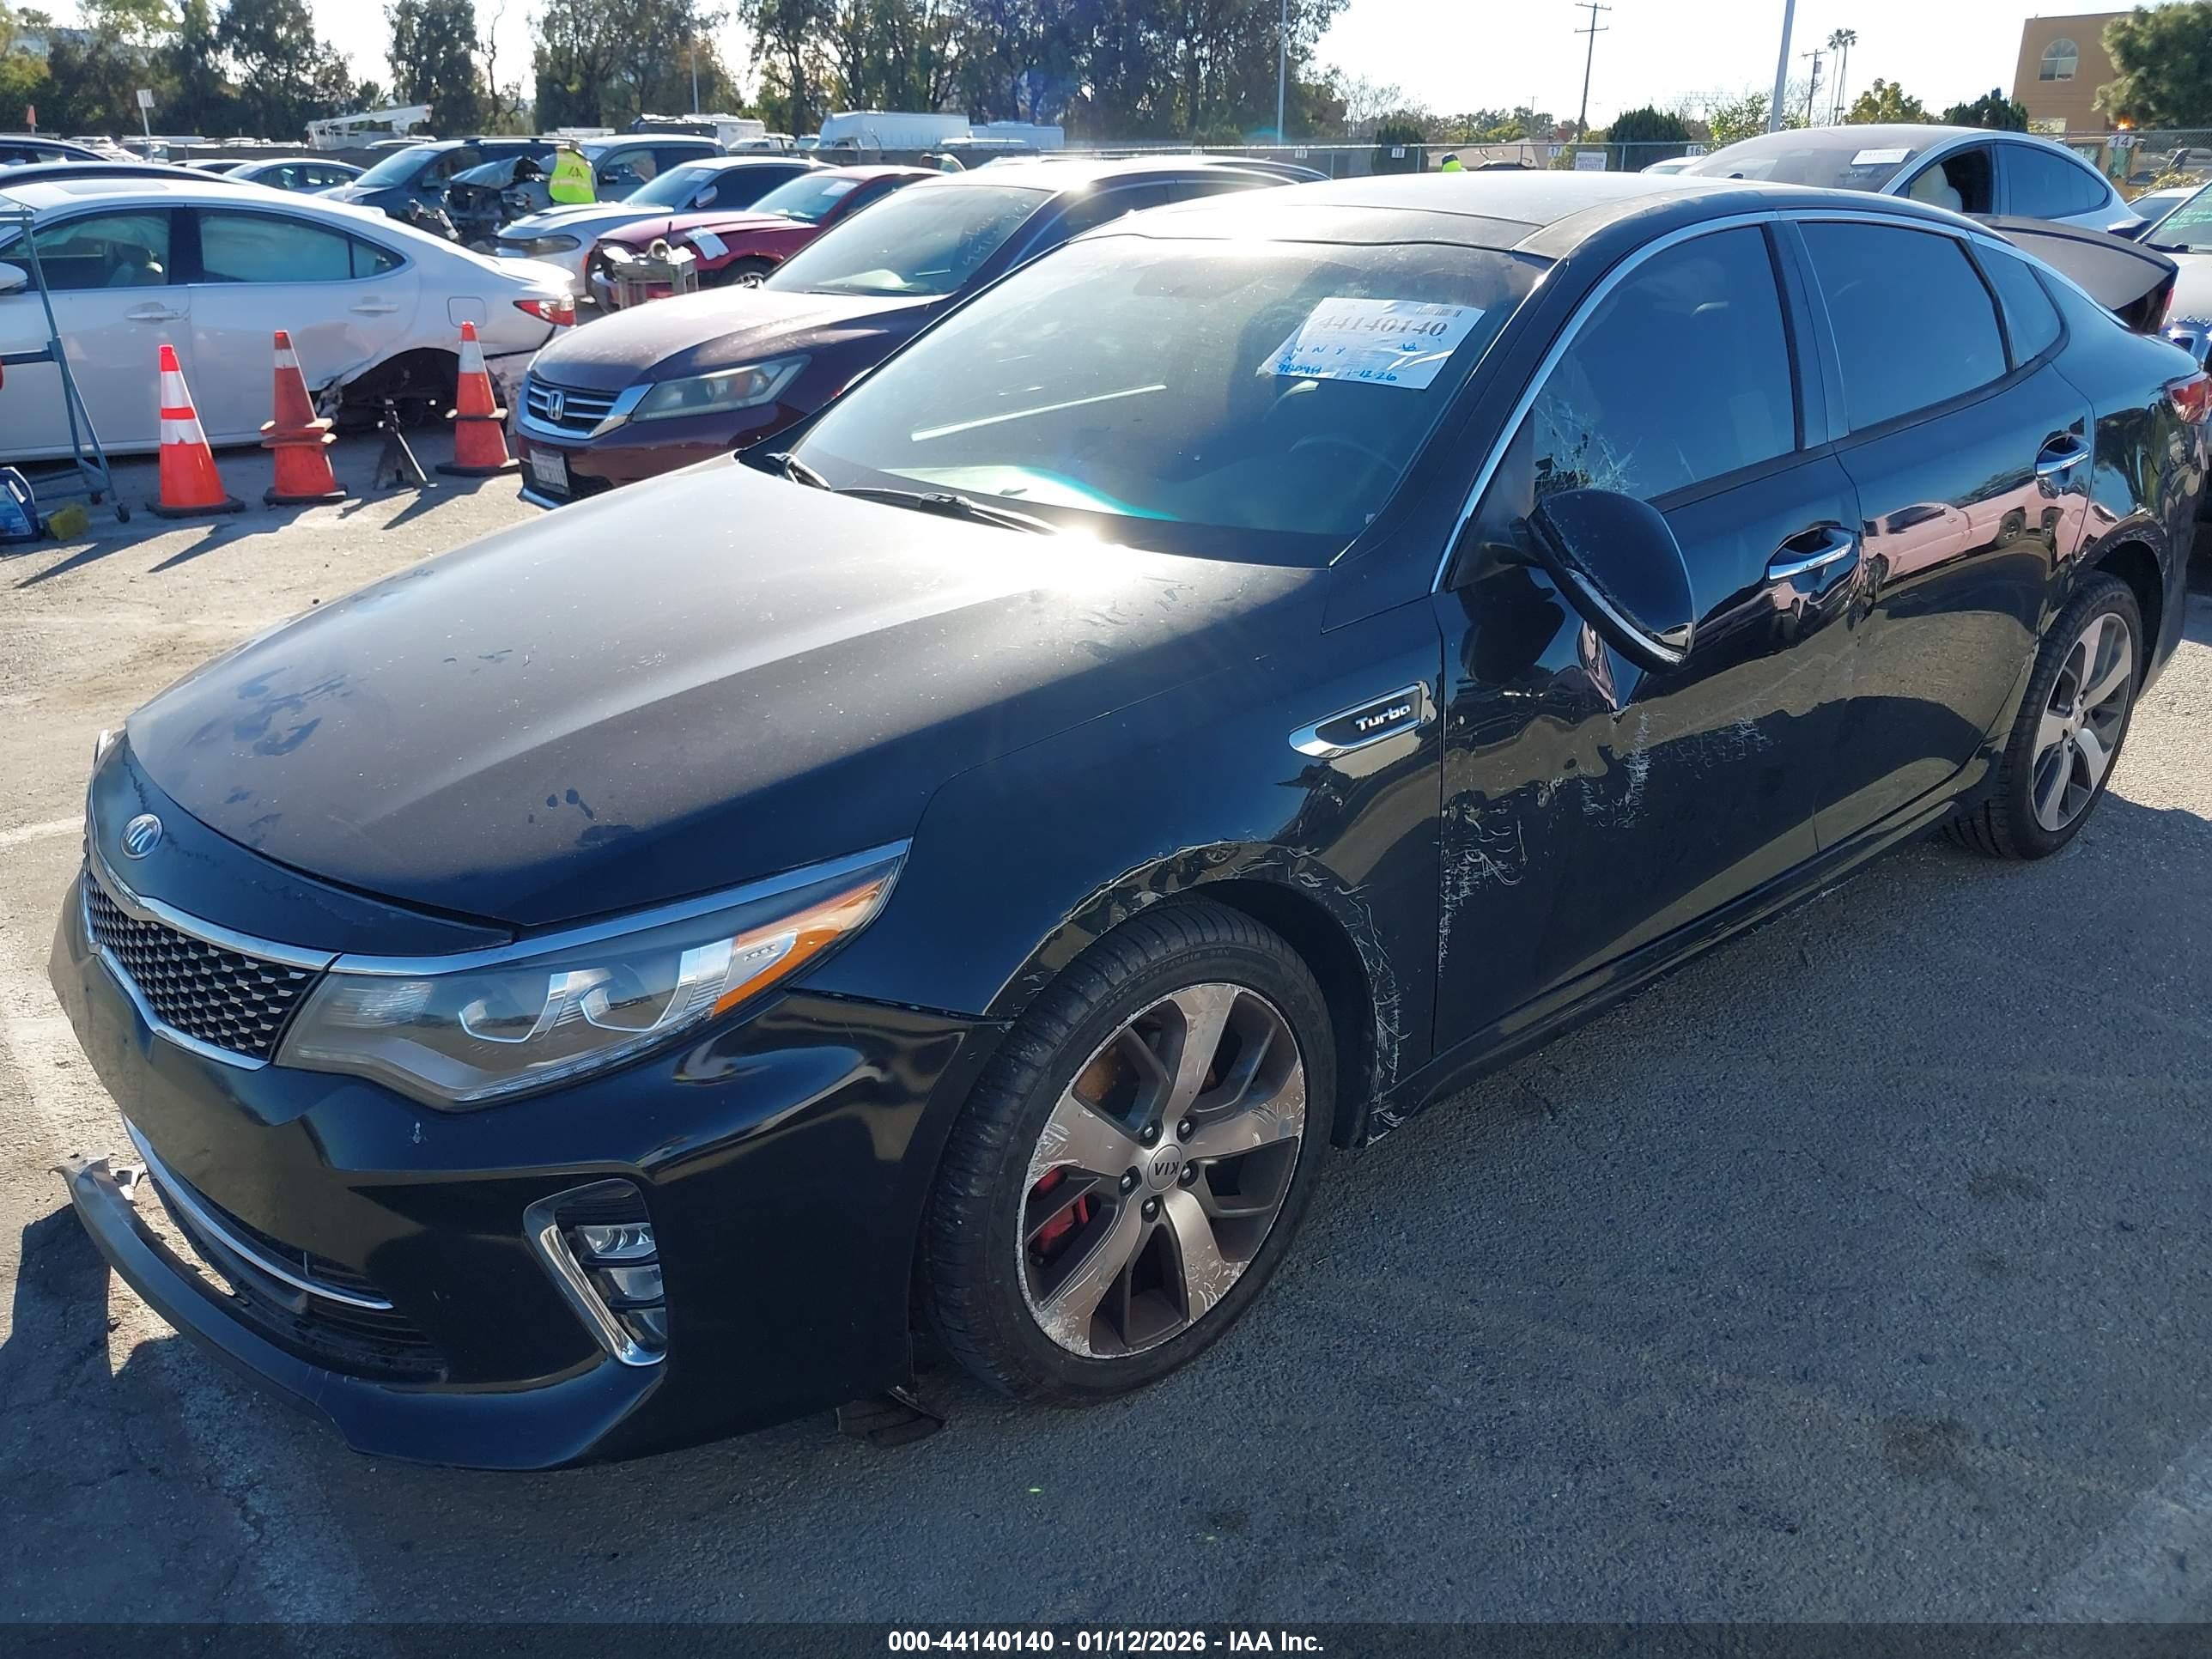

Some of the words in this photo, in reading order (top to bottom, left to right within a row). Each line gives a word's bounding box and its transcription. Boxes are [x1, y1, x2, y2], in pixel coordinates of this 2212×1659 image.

[2113, 136, 2130, 146] 14
[1551, 147, 1561, 157] 17
[1691, 147, 1700, 155] 16
[1318, 317, 1448, 337] 44140140
[1355, 704, 1411, 732] Turbo
[1154, 1161, 1179, 1176] KIA
